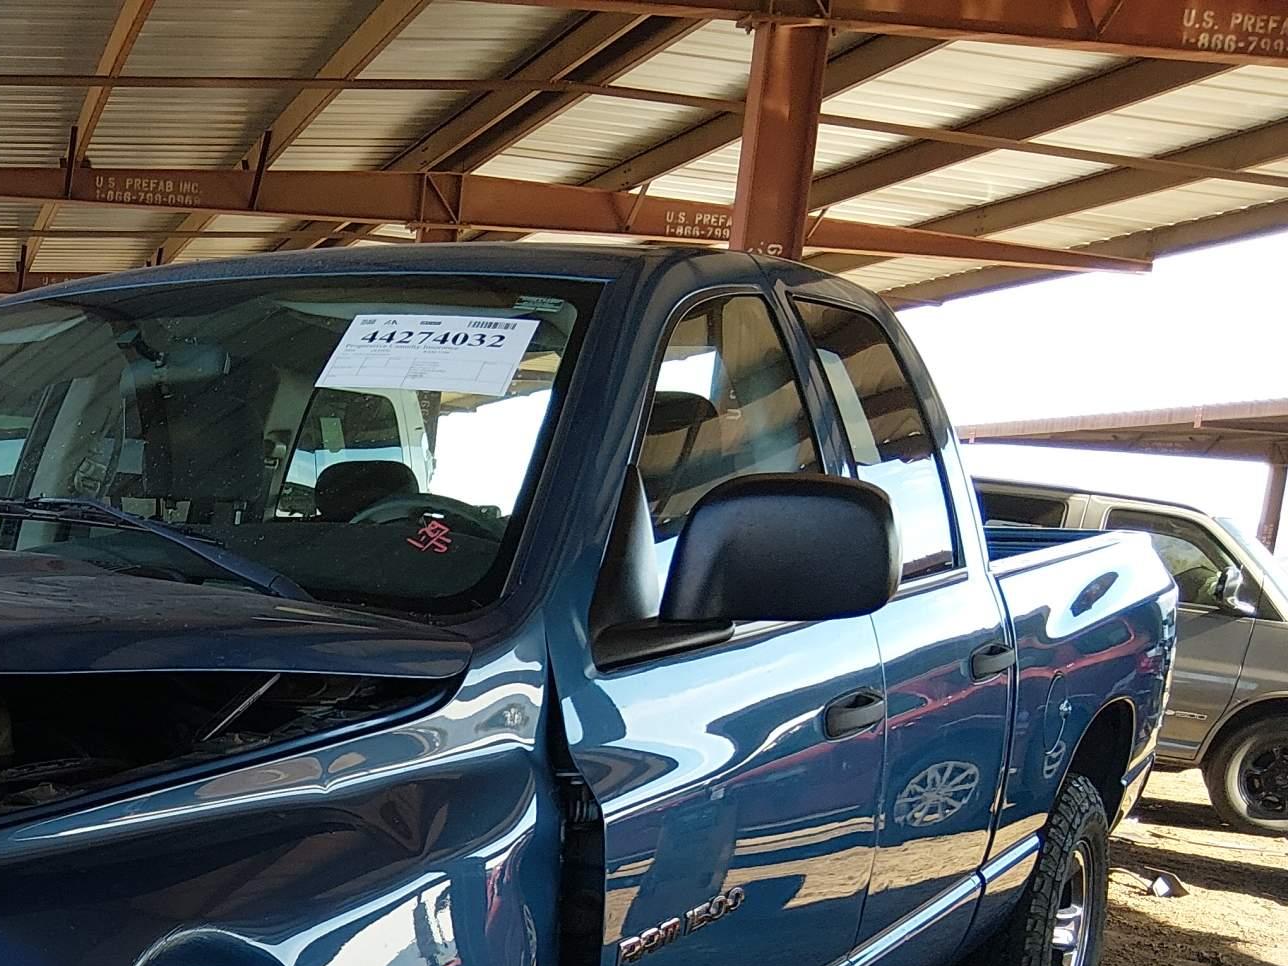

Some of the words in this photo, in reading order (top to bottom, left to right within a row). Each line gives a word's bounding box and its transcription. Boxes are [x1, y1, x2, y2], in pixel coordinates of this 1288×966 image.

[1183, 8, 1219, 30] U.S.
[125, 177, 174, 193] PREFAB
[179, 180, 203, 194] INC.
[360, 330, 506, 348] 44274032
[683, 887, 745, 937] 1500
